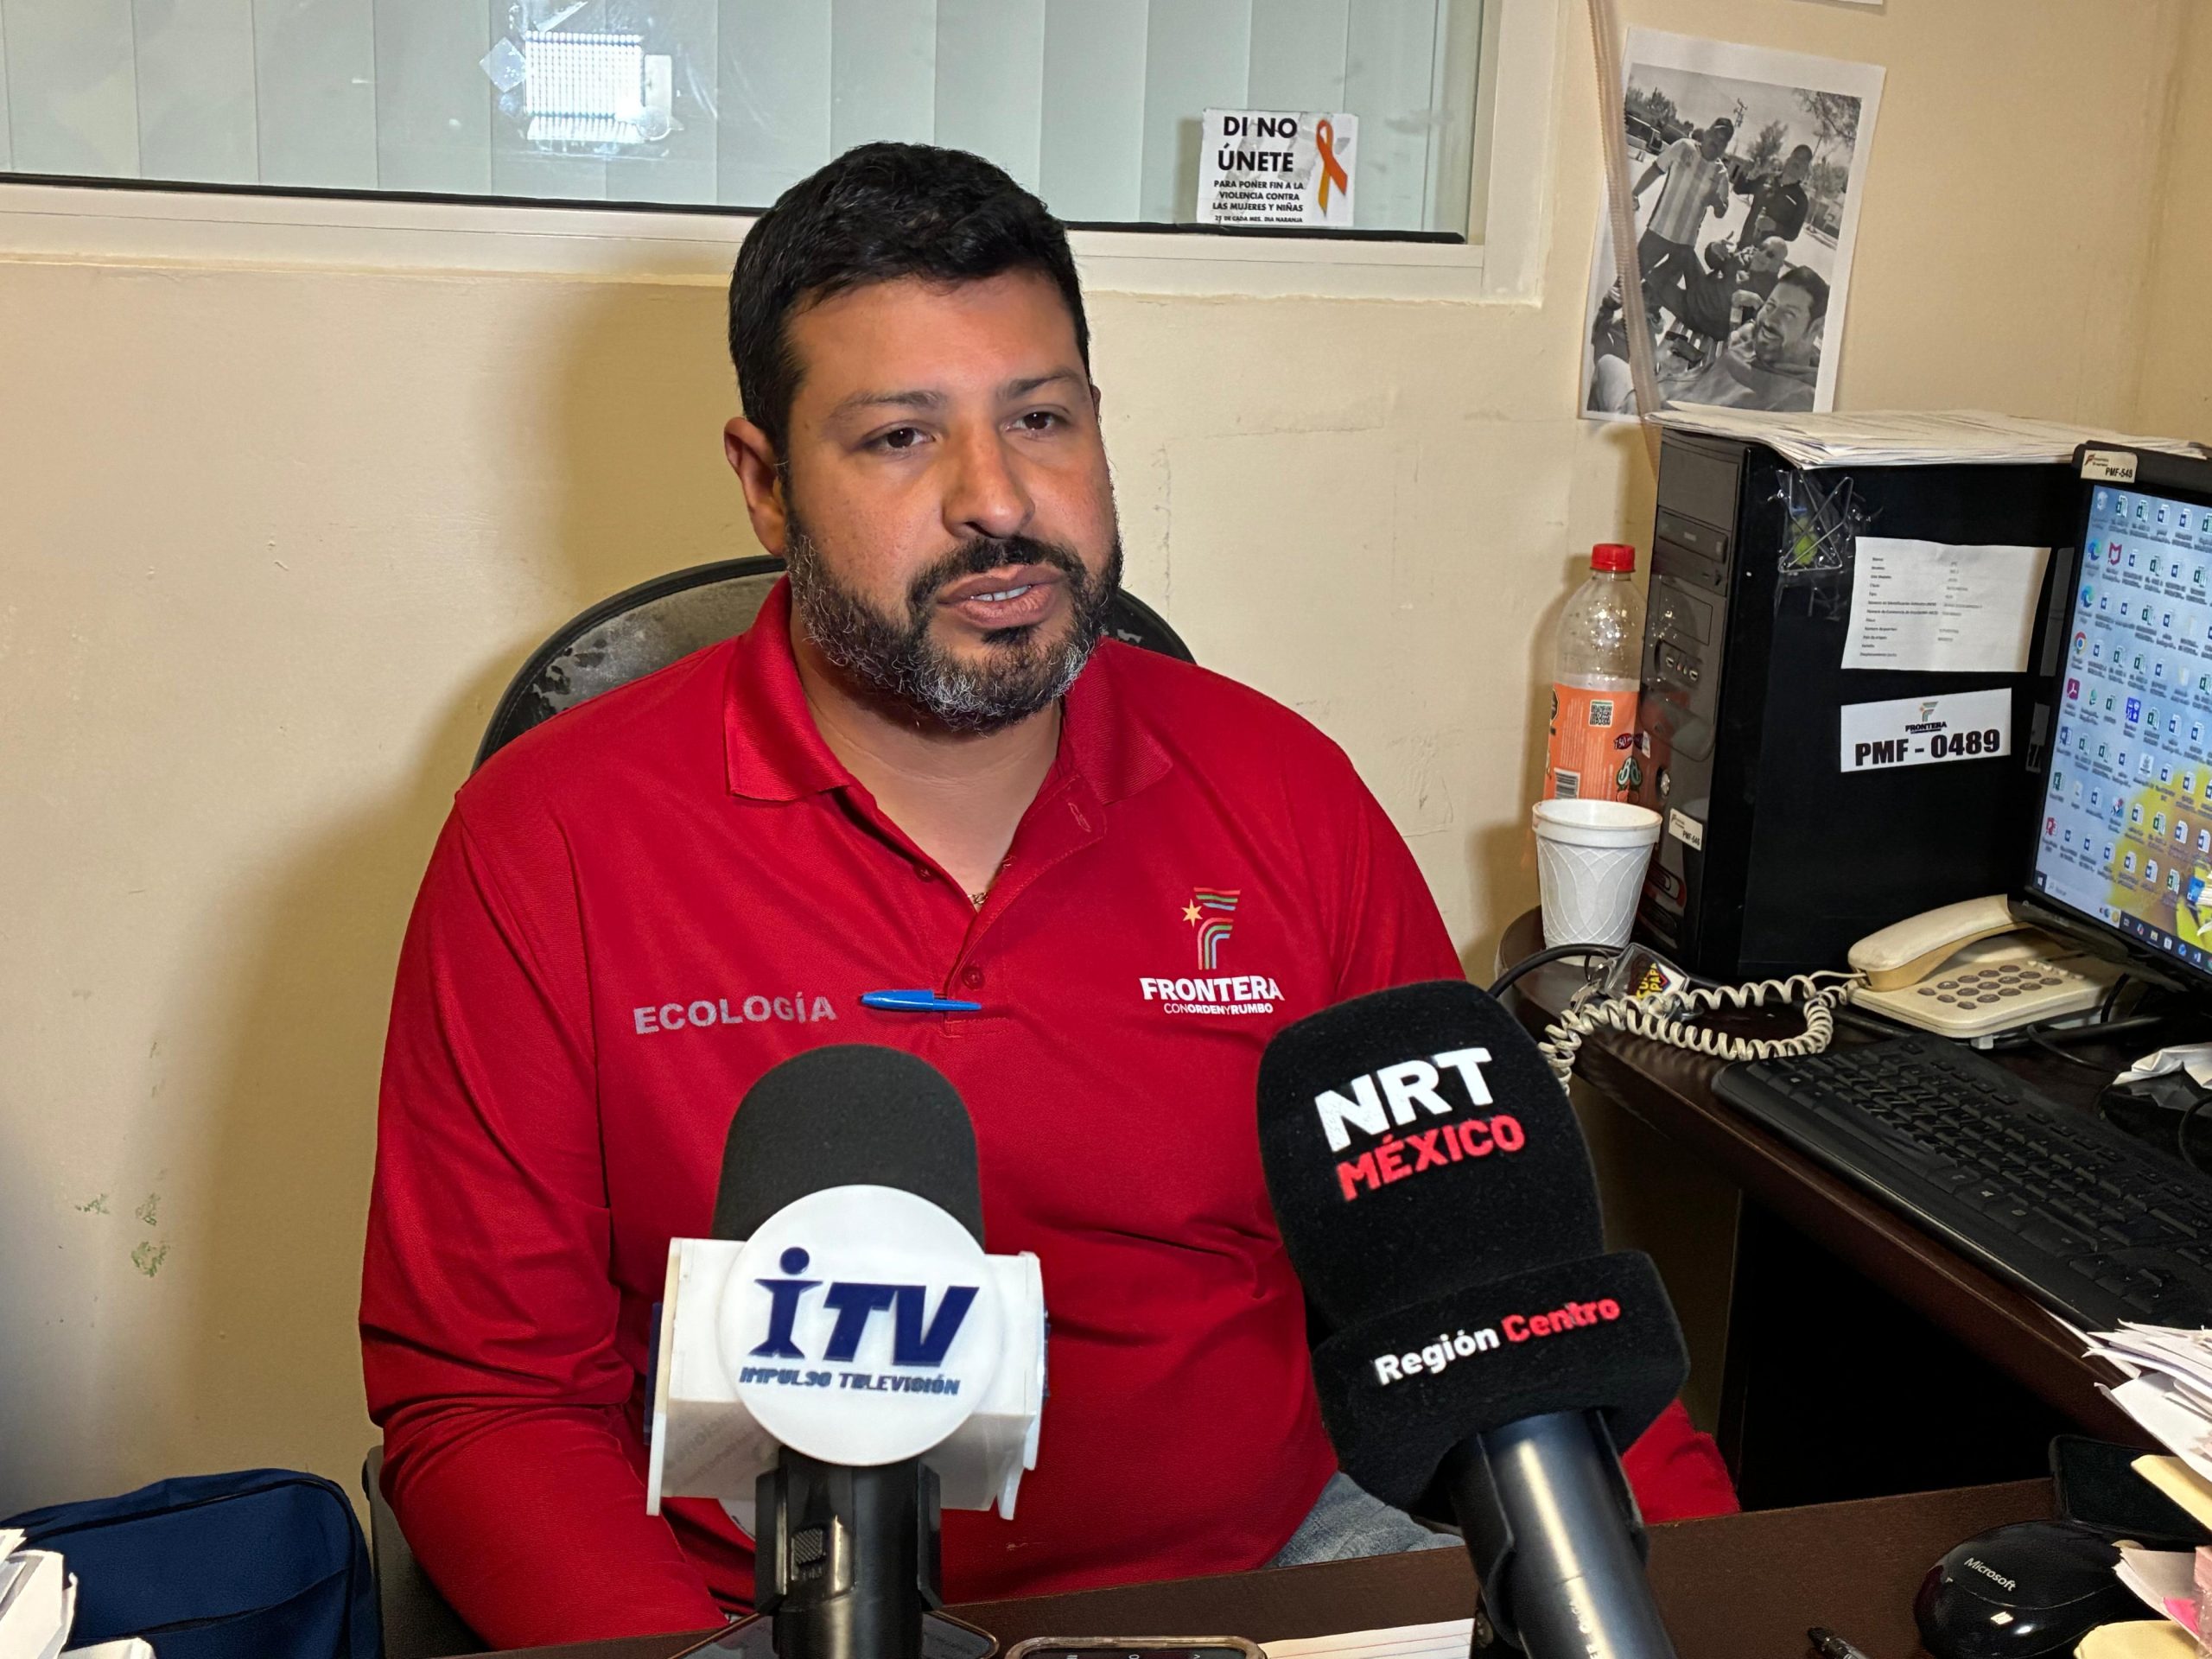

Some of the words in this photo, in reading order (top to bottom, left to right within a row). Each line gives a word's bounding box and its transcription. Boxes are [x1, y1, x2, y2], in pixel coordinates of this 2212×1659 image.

[1224, 116, 1248, 137] DI
[1257, 118, 1297, 138] NO
[1218, 143, 1294, 172] ÚNETE
[1219, 191, 1263, 200] VIOLENCIA
[1239, 180, 1267, 188] PONER
[1230, 202, 1266, 211] MUJERES
[1276, 202, 1303, 212] NIÑAS
[1855, 738, 1909, 766] PMF
[1930, 729, 2000, 759] 0489
[1139, 975, 1286, 1001] FRONTERA
[633, 991, 837, 1035] ECOLOGÍA
[1314, 1046, 1493, 1153] NRT
[1336, 1115, 1526, 1202] MÉXICO
[1374, 1326, 1500, 1385] Región
[1502, 1298, 1621, 1343] Centro
[838, 1374, 961, 1395] TELEVISIÓN
[1964, 1557, 2016, 1592] Microsoft
